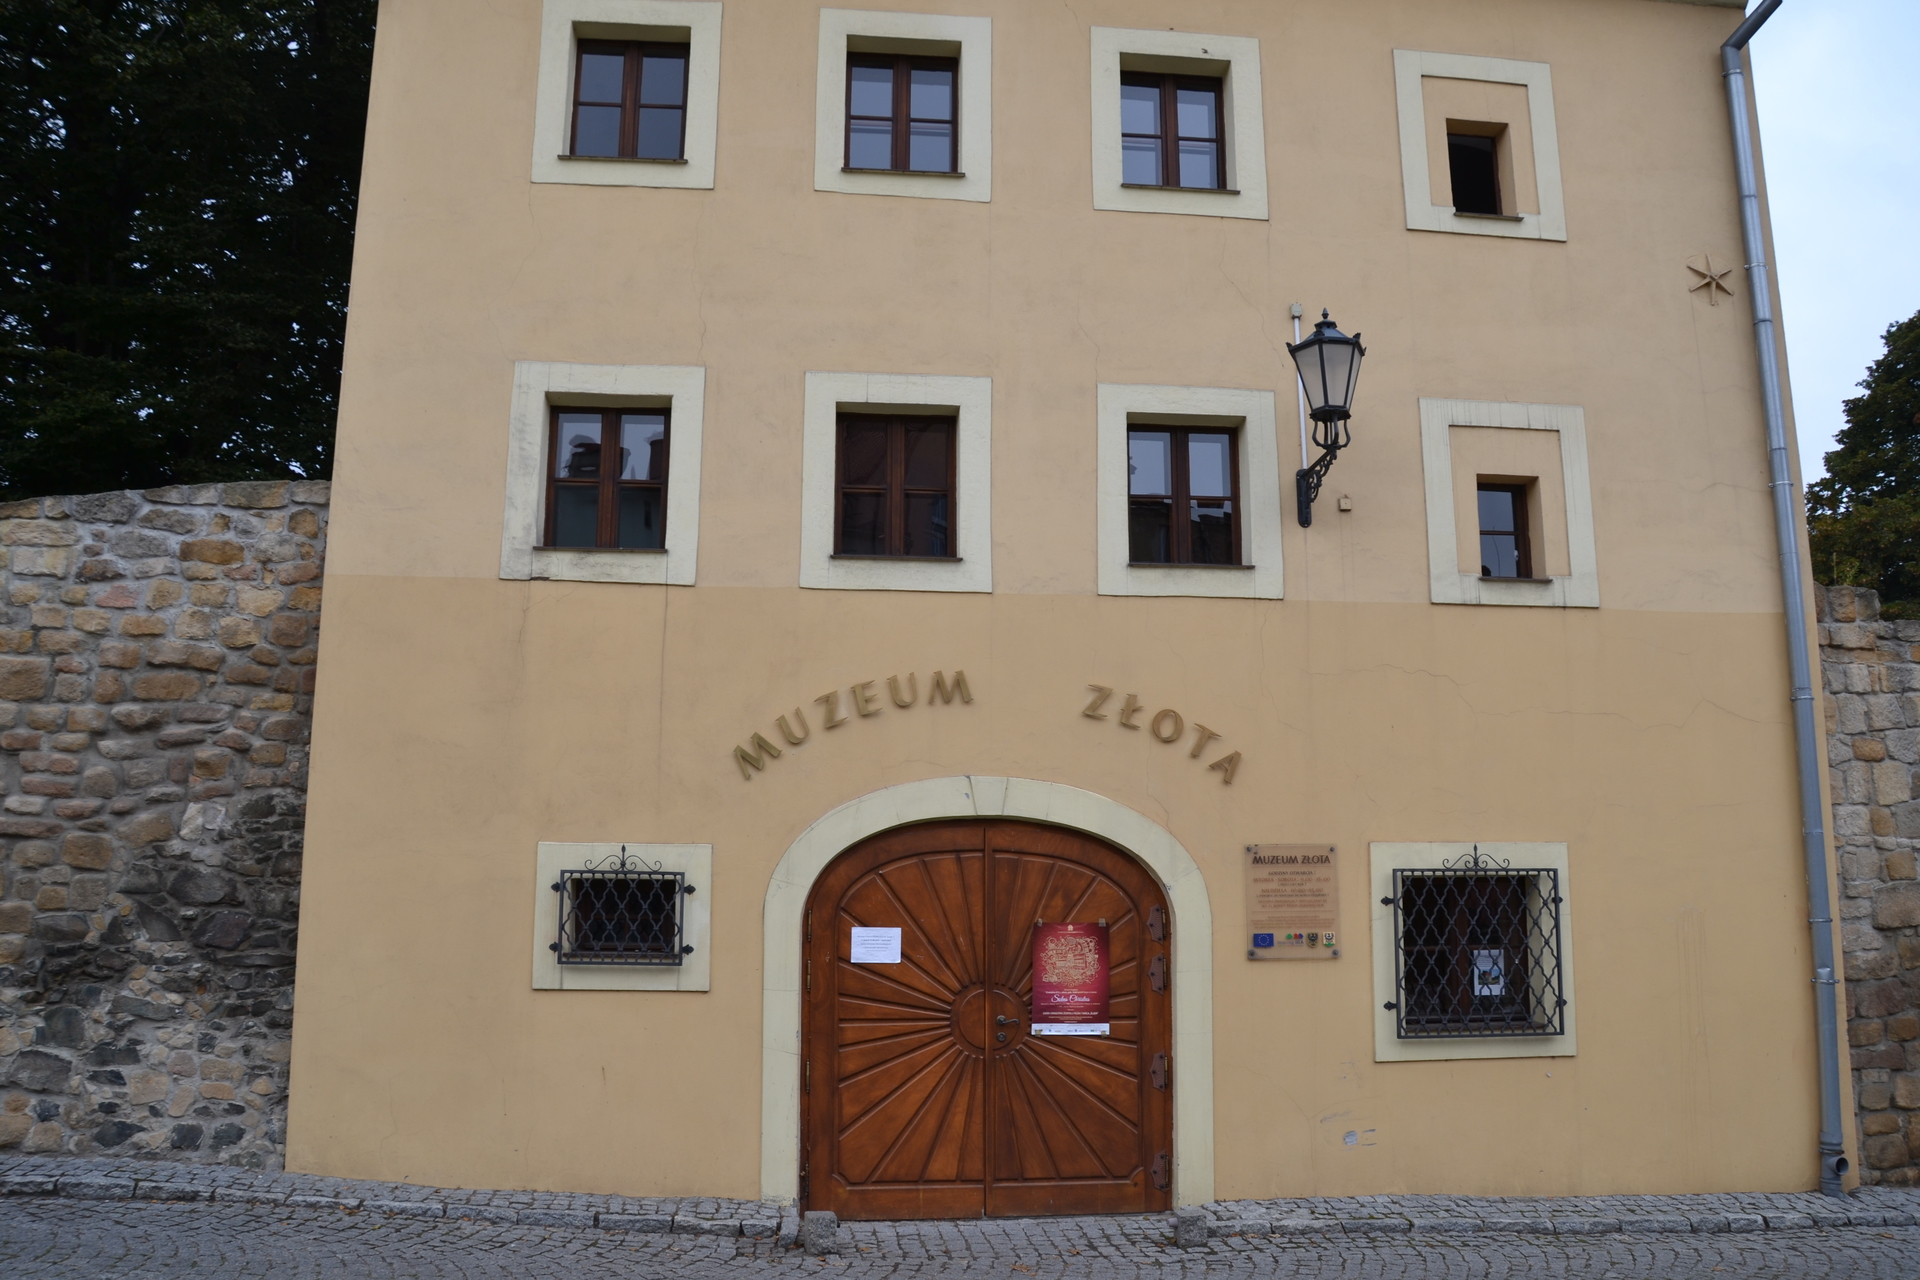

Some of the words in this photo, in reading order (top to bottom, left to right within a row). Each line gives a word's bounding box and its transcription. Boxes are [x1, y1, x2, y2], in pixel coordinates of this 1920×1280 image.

[733, 670, 974, 781] MUZEUM
[1081, 684, 1242, 785] ZŁOTA
[1252, 855, 1299, 865] MUZEUM
[1301, 855, 1331, 864] ZŁOTA
